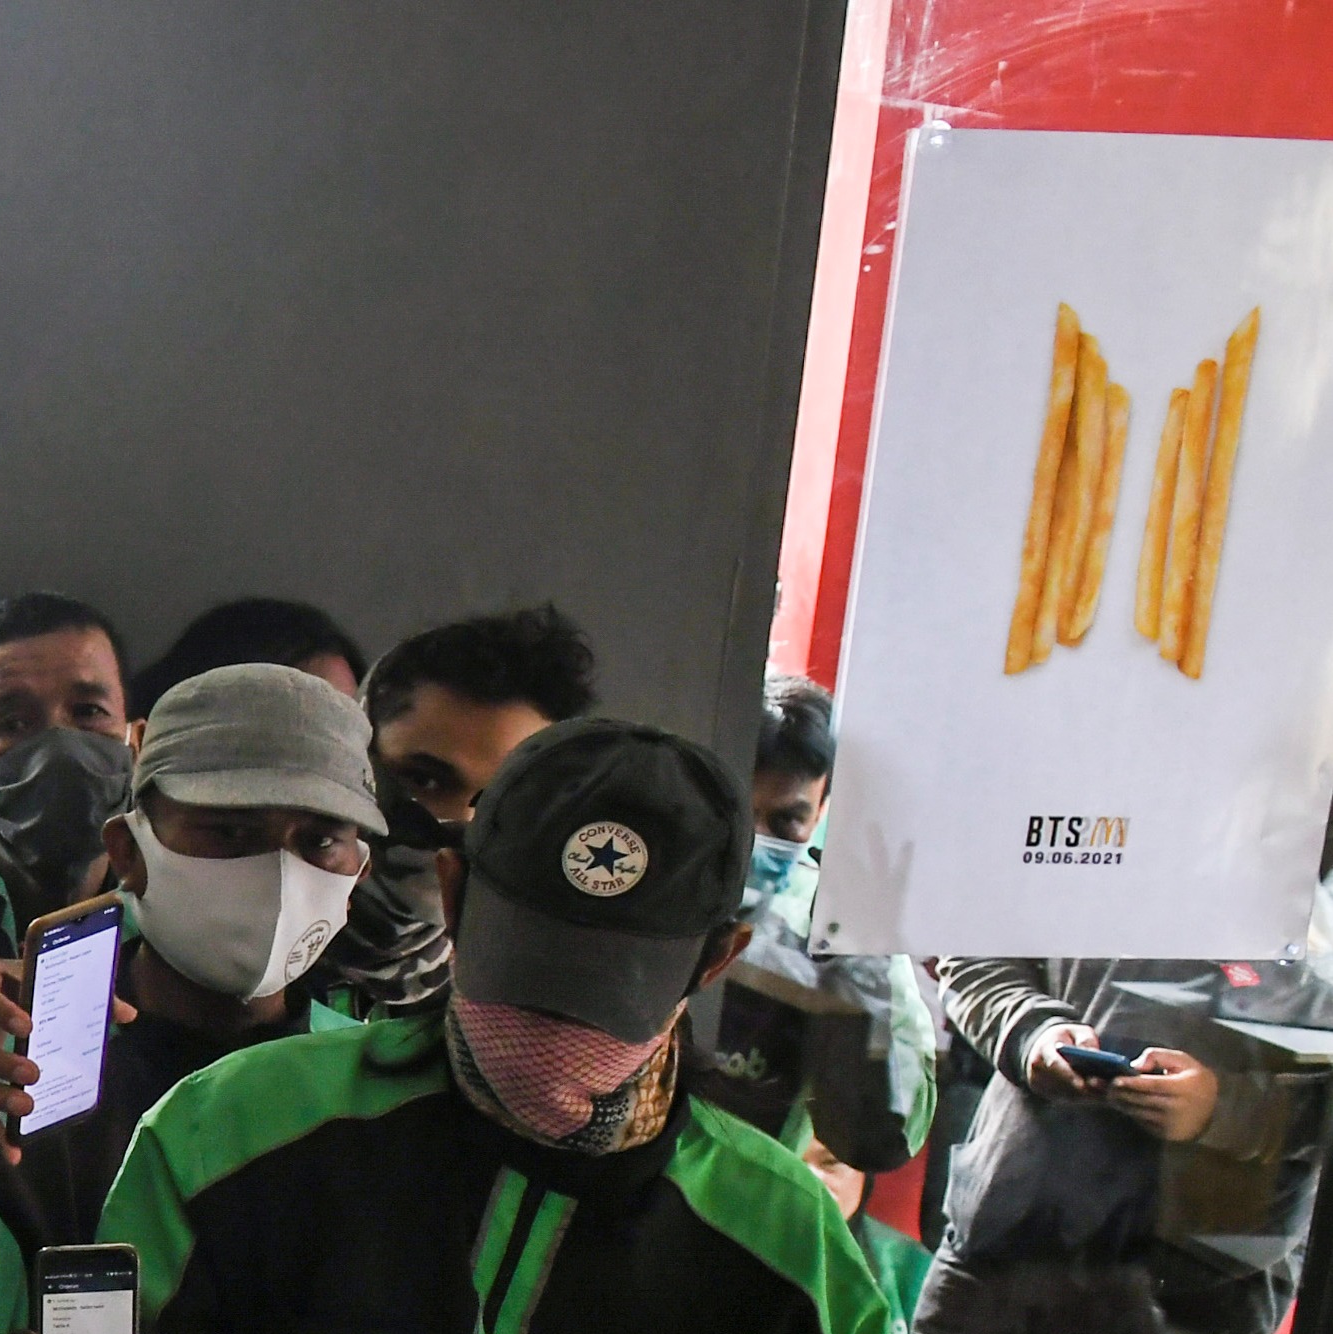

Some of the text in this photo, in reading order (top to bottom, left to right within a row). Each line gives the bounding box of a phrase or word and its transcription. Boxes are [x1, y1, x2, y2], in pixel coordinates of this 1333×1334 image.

[578, 825, 641, 854] CONVERSE
[1025, 816, 1084, 847] BTS
[1022, 851, 1123, 865] 09.06.2021
[569, 866, 626, 891] ALL STAR
